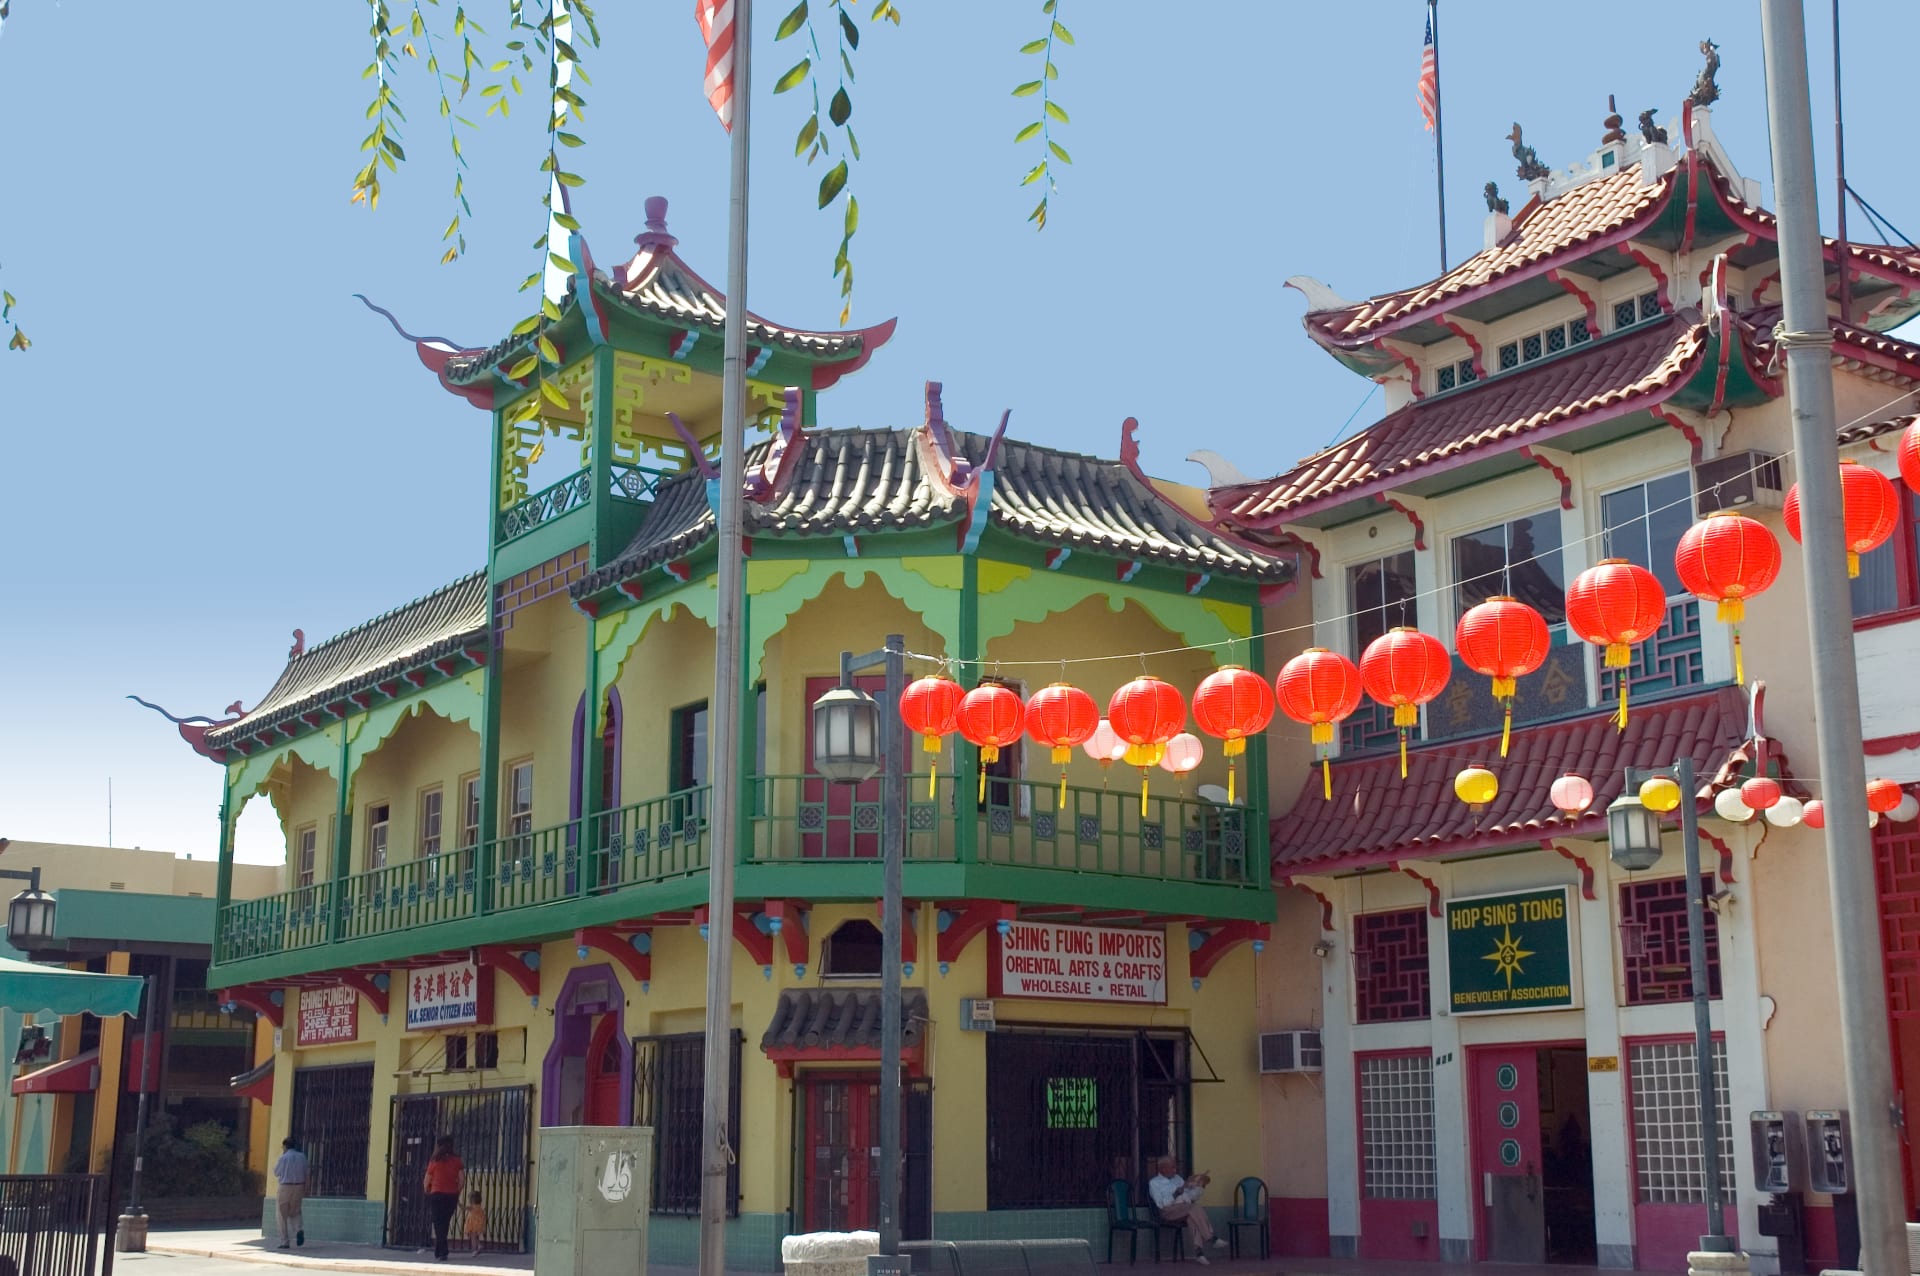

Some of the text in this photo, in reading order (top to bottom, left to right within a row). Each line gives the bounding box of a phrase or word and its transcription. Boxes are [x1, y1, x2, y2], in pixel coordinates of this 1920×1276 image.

[1451, 898, 1563, 930] HOP SING TONG
[1005, 926, 1162, 959] SHING FUNG IMPORTS
[1006, 955, 1161, 981] ORIENTAL ARTS & CRAFTS
[301, 989, 323, 1010] SHING
[323, 986, 345, 1008] FUNG
[1021, 979, 1147, 998] WHOLESALE RETAIL
[1454, 985, 1569, 1004] BENEVOLENT ASSOCIATION
[420, 1005, 439, 1022] SENIOR
[440, 1002, 461, 1020] CITIZEN
[301, 1025, 352, 1040] ARTS FURNITURE
[304, 1017, 328, 1030] CHINESE
